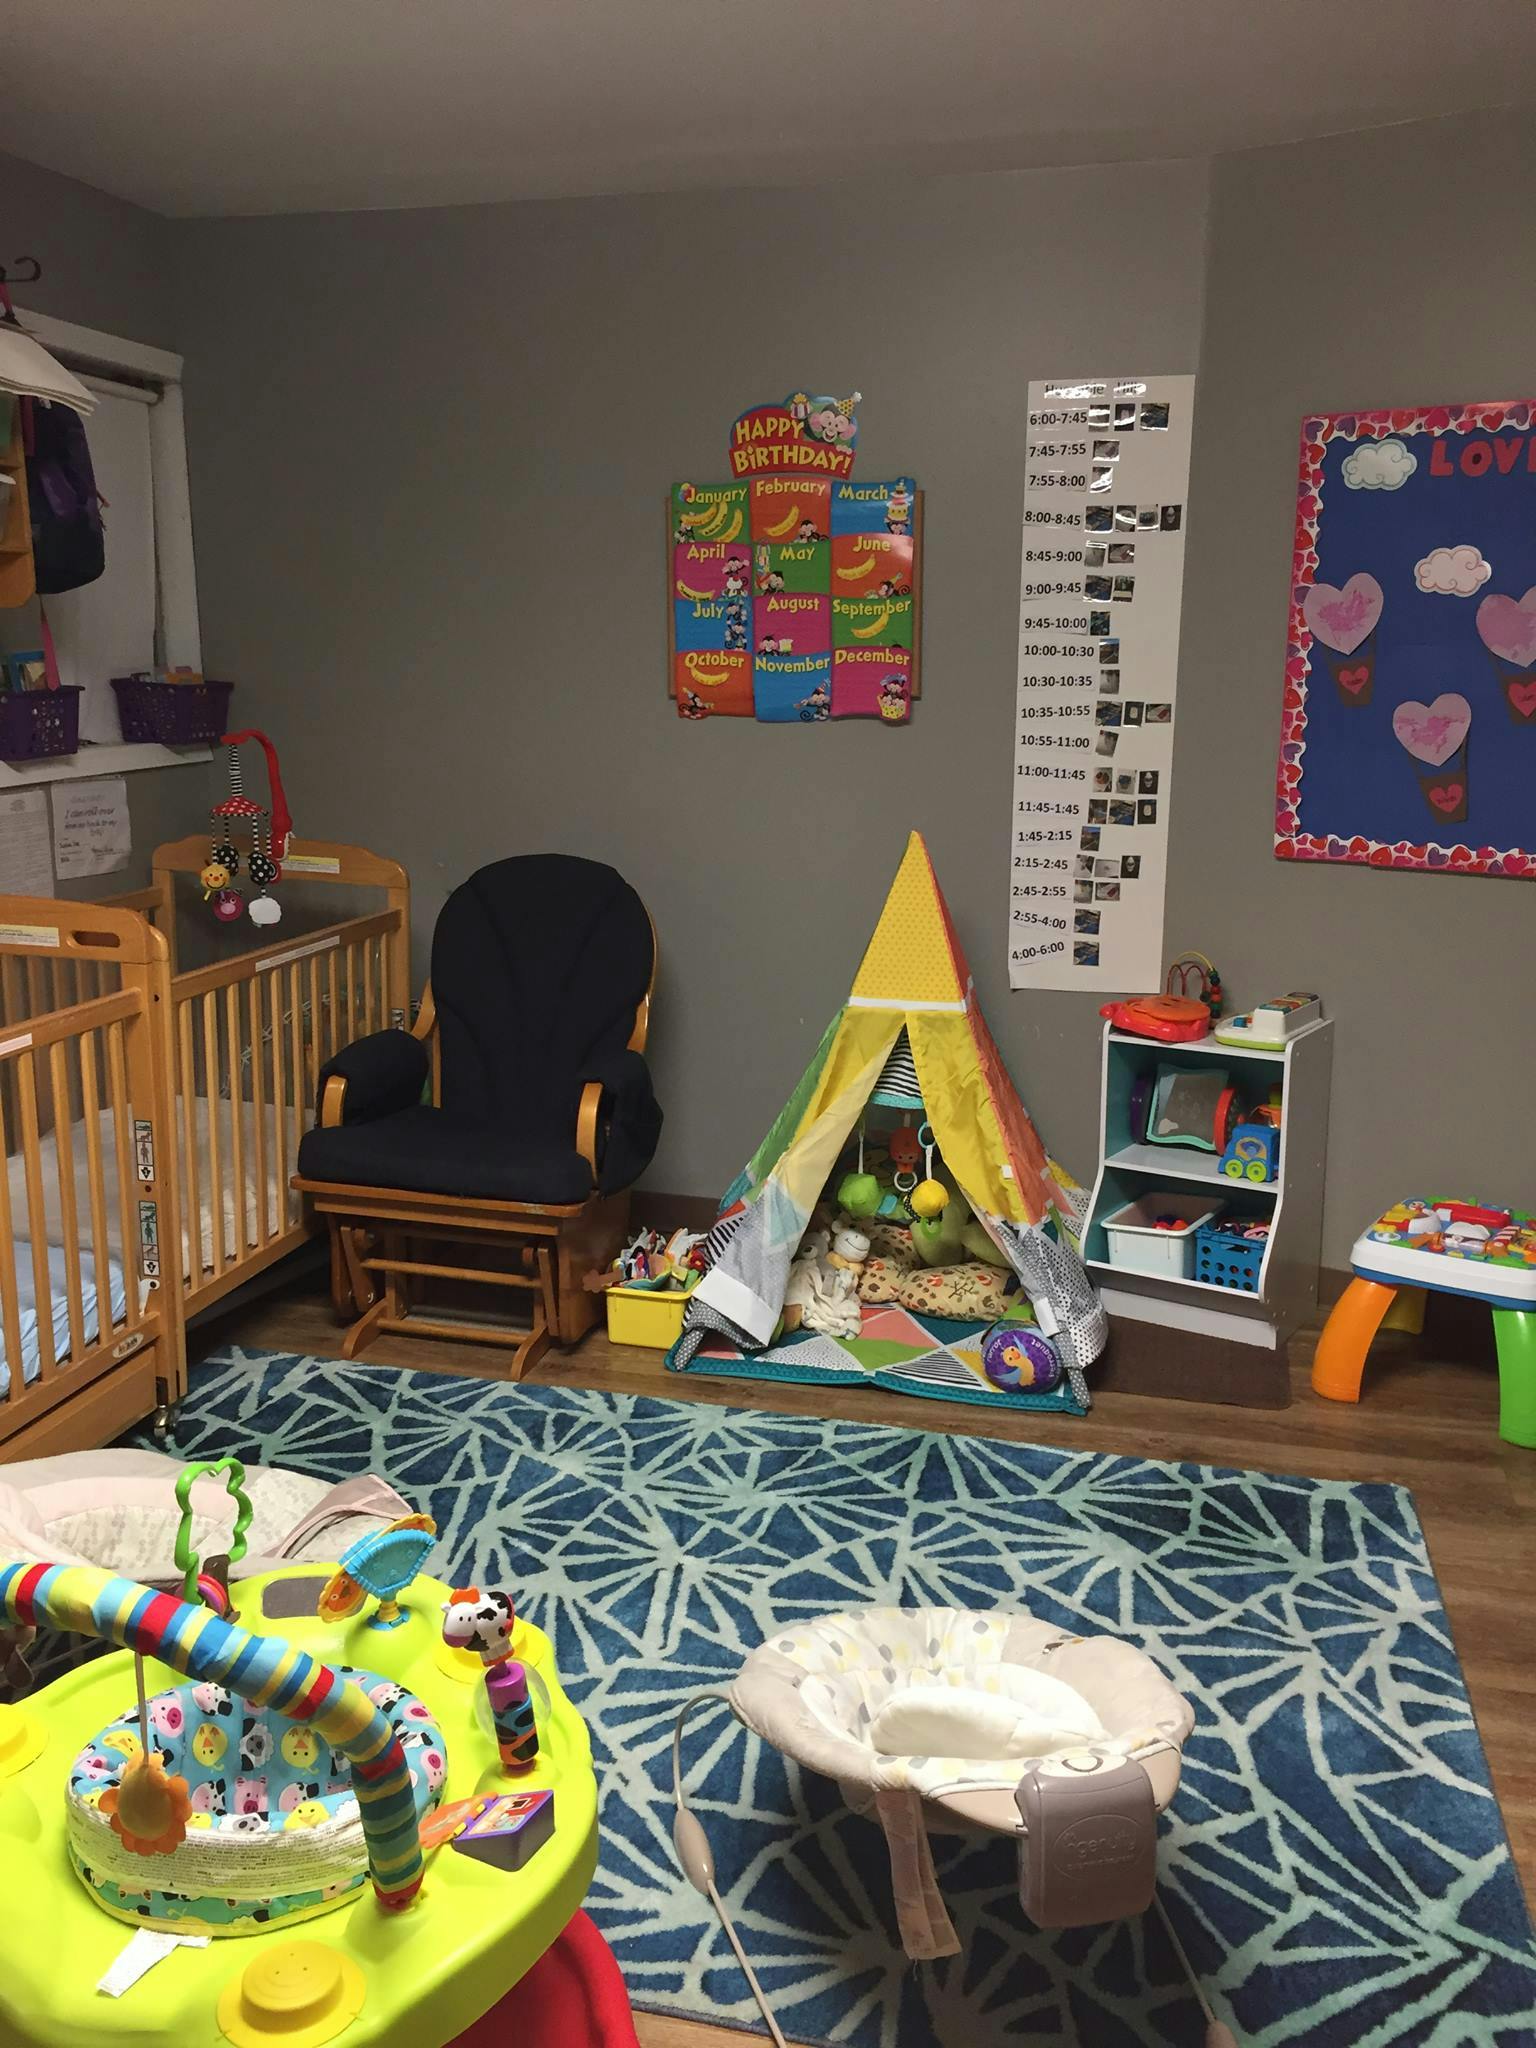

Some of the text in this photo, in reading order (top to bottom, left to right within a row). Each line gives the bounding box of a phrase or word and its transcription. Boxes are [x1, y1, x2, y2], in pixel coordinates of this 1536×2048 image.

[1030, 412, 1087, 425] 6:00-7:45
[736, 417, 804, 444] HAPPY
[1029, 443, 1086, 457] 7:45-7:55
[756, 478, 826, 497] February
[1029, 475, 1086, 486] 7:55-8:00
[686, 487, 747, 504] January
[838, 484, 888, 500] March
[1025, 511, 1080, 525] 8:00-8:45
[852, 536, 891, 551] June
[686, 544, 726, 563] April
[780, 547, 815, 561] May
[1025, 551, 1082, 561] 8:45-9:00
[1026, 583, 1081, 595] 9:00-9:45
[692, 603, 724, 619] July
[767, 597, 820, 612] August
[832, 600, 911, 619] September
[1024, 618, 1087, 629] 9:45-10:00
[835, 650, 910, 666] December
[1024, 645, 1094, 657] 10:00-10:30
[684, 652, 744, 668] October
[755, 656, 830, 673] November
[1023, 676, 1092, 687] 10:30-10:35
[1021, 705, 1090, 718] 10:35-10:55
[1021, 735, 1089, 748] 10:55-11:00
[1017, 765, 1086, 780] 11:00-11:45
[1018, 801, 1079, 815] 11:45-1:45
[1018, 831, 1072, 841] 1:45-2:15
[1014, 857, 1068, 870] 2:15-2:45
[1012, 886, 1066, 896] 2:45-2:55
[1013, 910, 1067, 929] 2:55-4:00
[1012, 941, 1065, 961] 4:00-6:00
